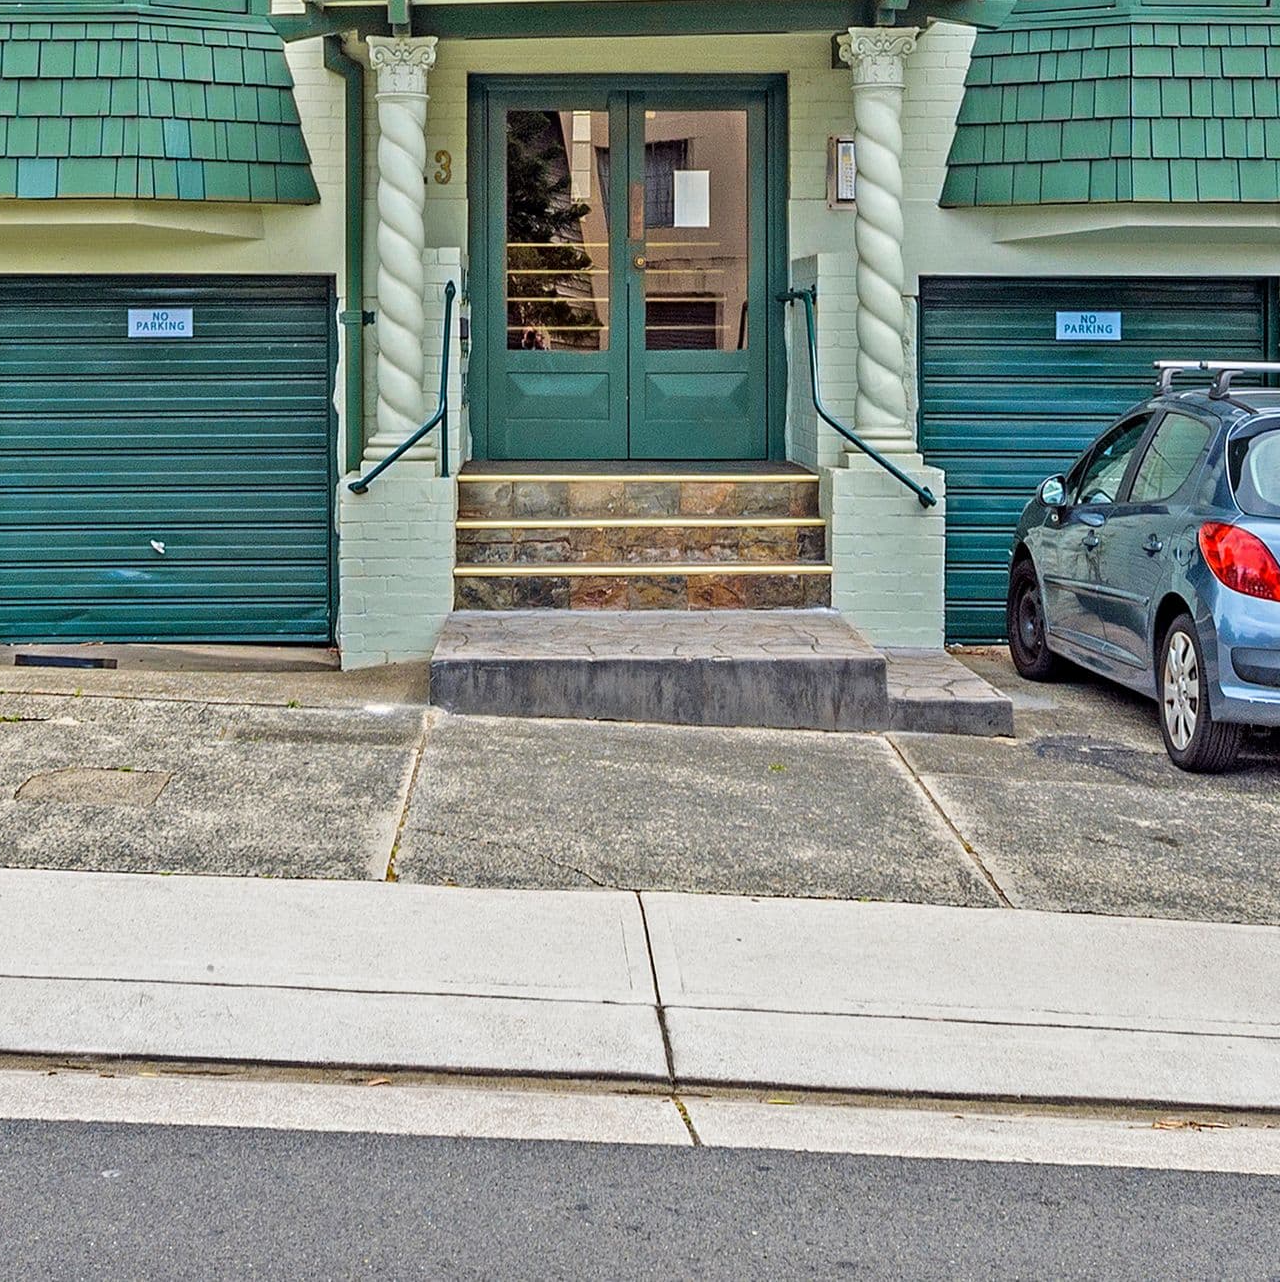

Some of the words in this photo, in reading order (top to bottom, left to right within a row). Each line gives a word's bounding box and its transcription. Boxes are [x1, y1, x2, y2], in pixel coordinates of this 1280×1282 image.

[434, 149, 452, 185] 3
[152, 311, 169, 321] NO
[1080, 314, 1097, 324] NO
[136, 321, 185, 331] PARKING
[1064, 324, 1113, 334] PARKING
